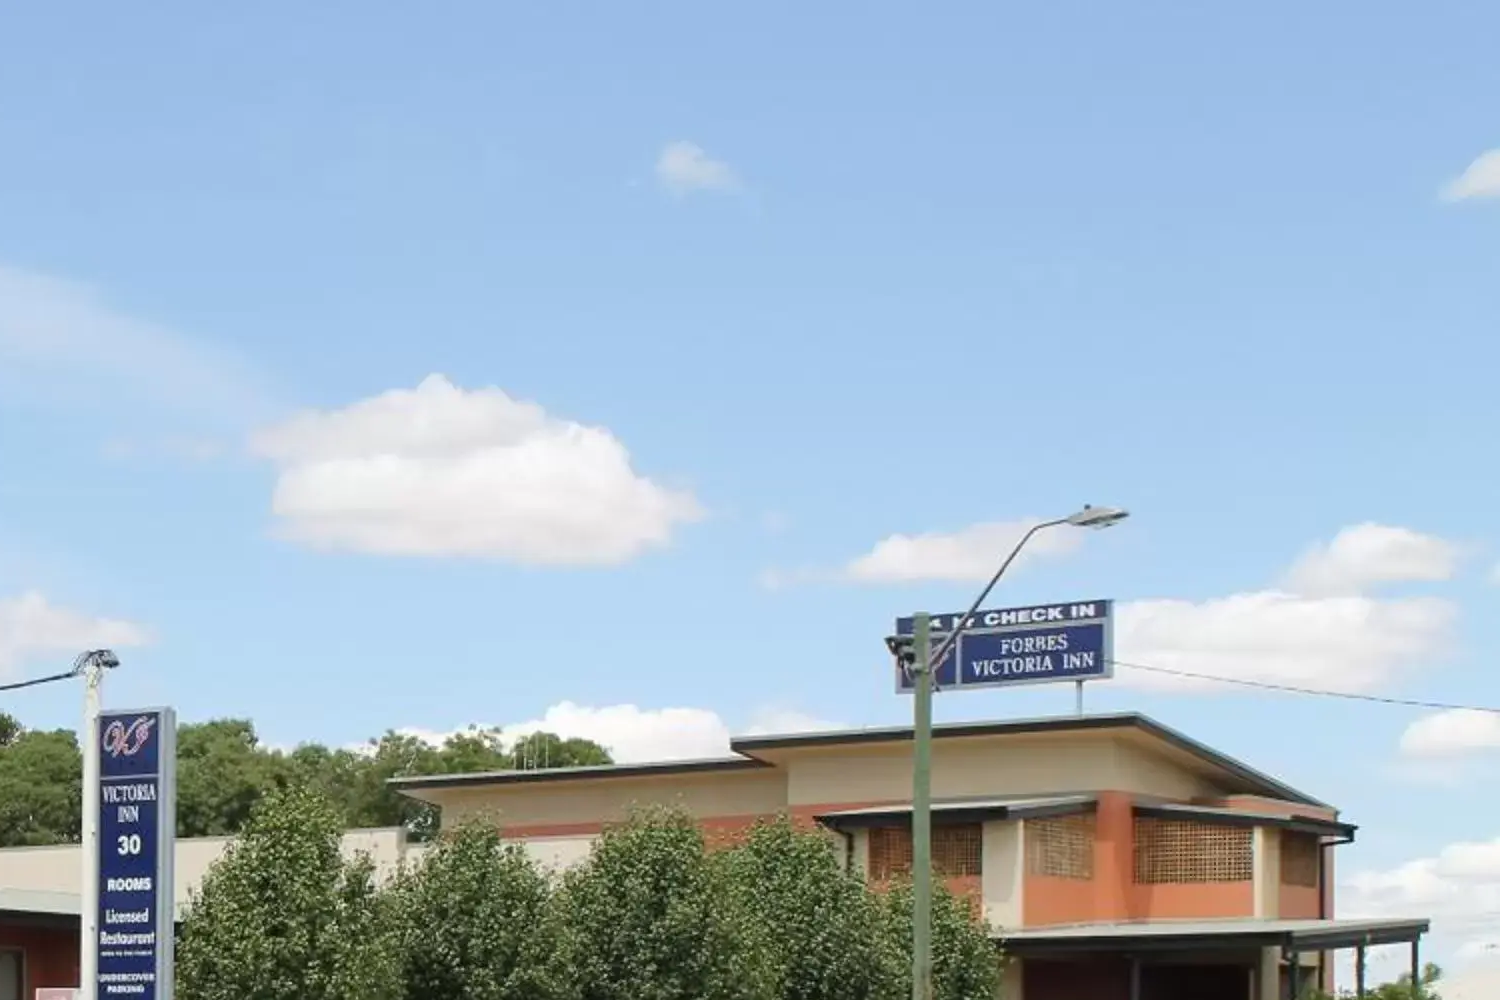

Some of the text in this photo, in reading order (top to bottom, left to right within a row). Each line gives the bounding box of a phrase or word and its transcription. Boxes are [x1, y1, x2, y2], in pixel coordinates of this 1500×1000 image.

[984, 607, 1064, 626] CHECK
[1070, 603, 1097, 619] IN
[1000, 634, 1069, 656] FORBES
[971, 651, 1095, 678] VICTORIA INN
[102, 783, 157, 803] VICTORIA
[117, 805, 140, 823] INN
[117, 833, 141, 855] 30
[107, 877, 152, 892] ROOMS
[105, 907, 149, 924] Licensed
[99, 931, 156, 945] Restaurant
[99, 973, 156, 983] UNDERCOVER
[106, 984, 146, 994] PARKING
